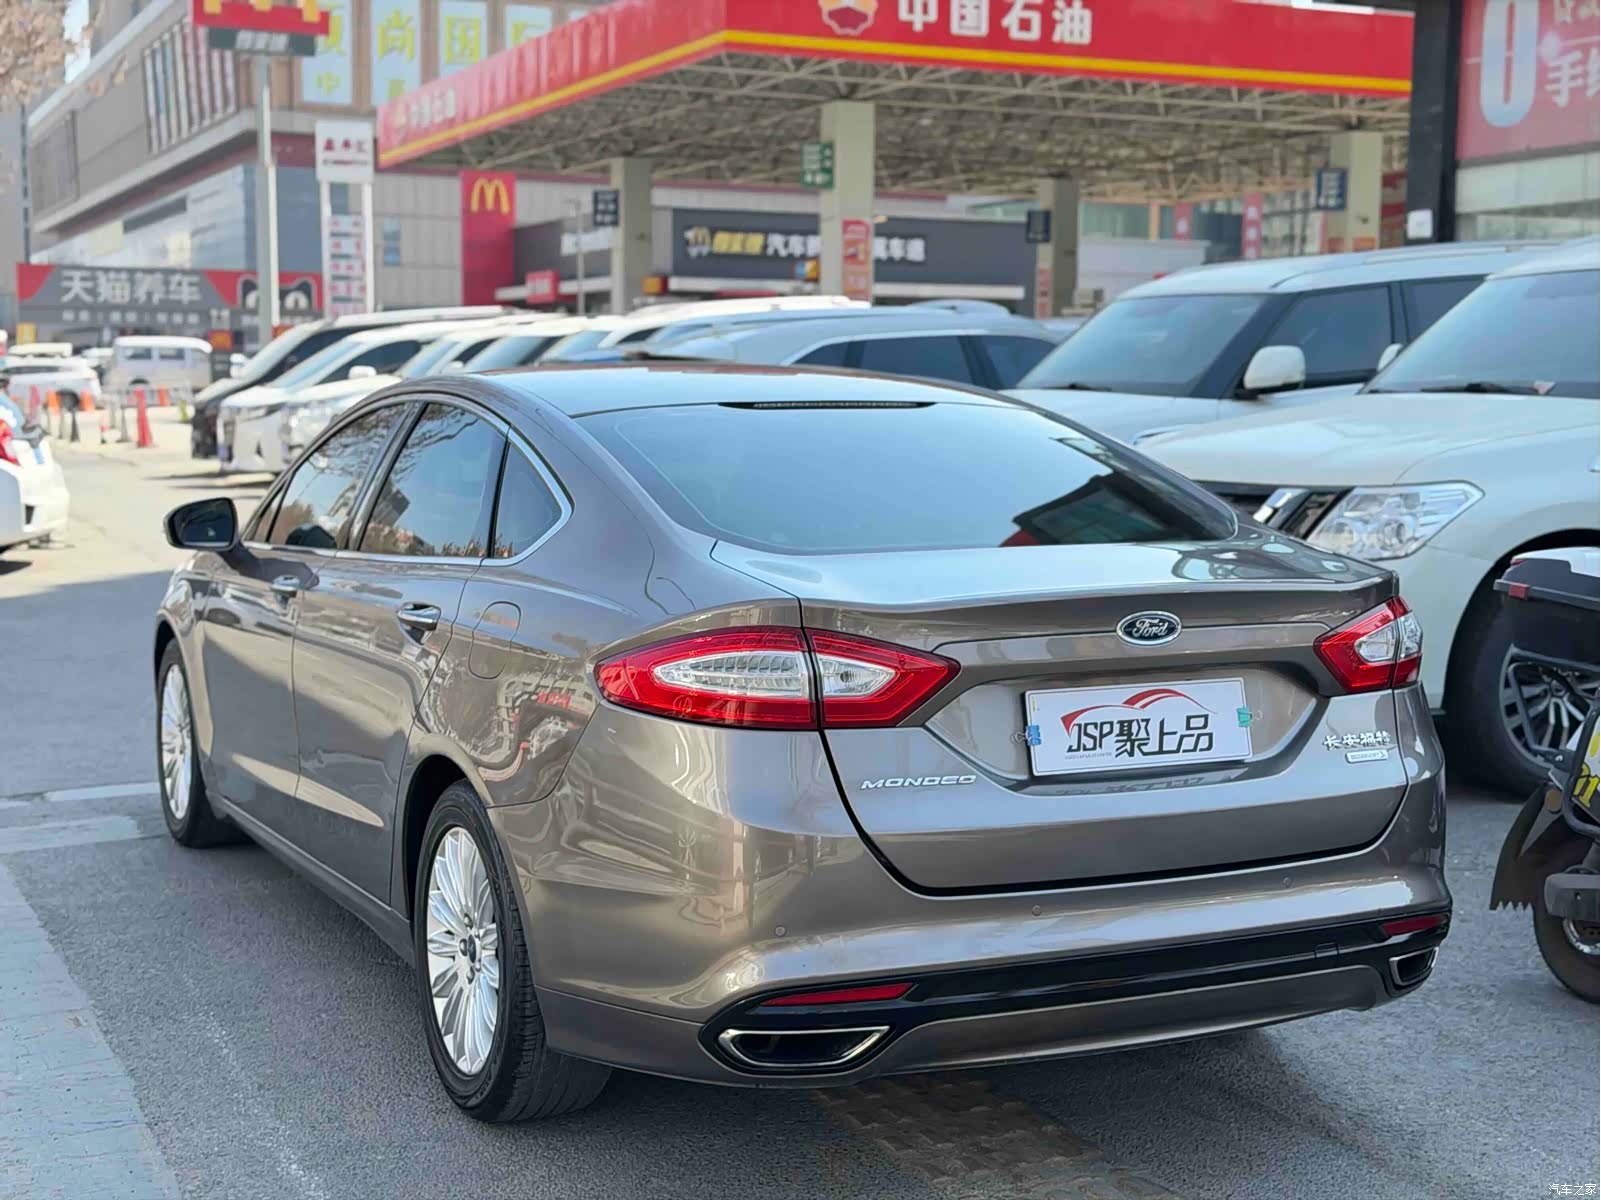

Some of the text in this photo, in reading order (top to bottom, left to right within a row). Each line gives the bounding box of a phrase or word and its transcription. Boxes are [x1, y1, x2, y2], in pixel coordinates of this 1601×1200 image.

[897, 0, 1093, 45] 中国石油
[61, 269, 201, 305] 天猫养车
[1132, 618, 1169, 638] Ford
[1323, 730, 1391, 751] 长安福特
[861, 775, 976, 790] MONDEO
